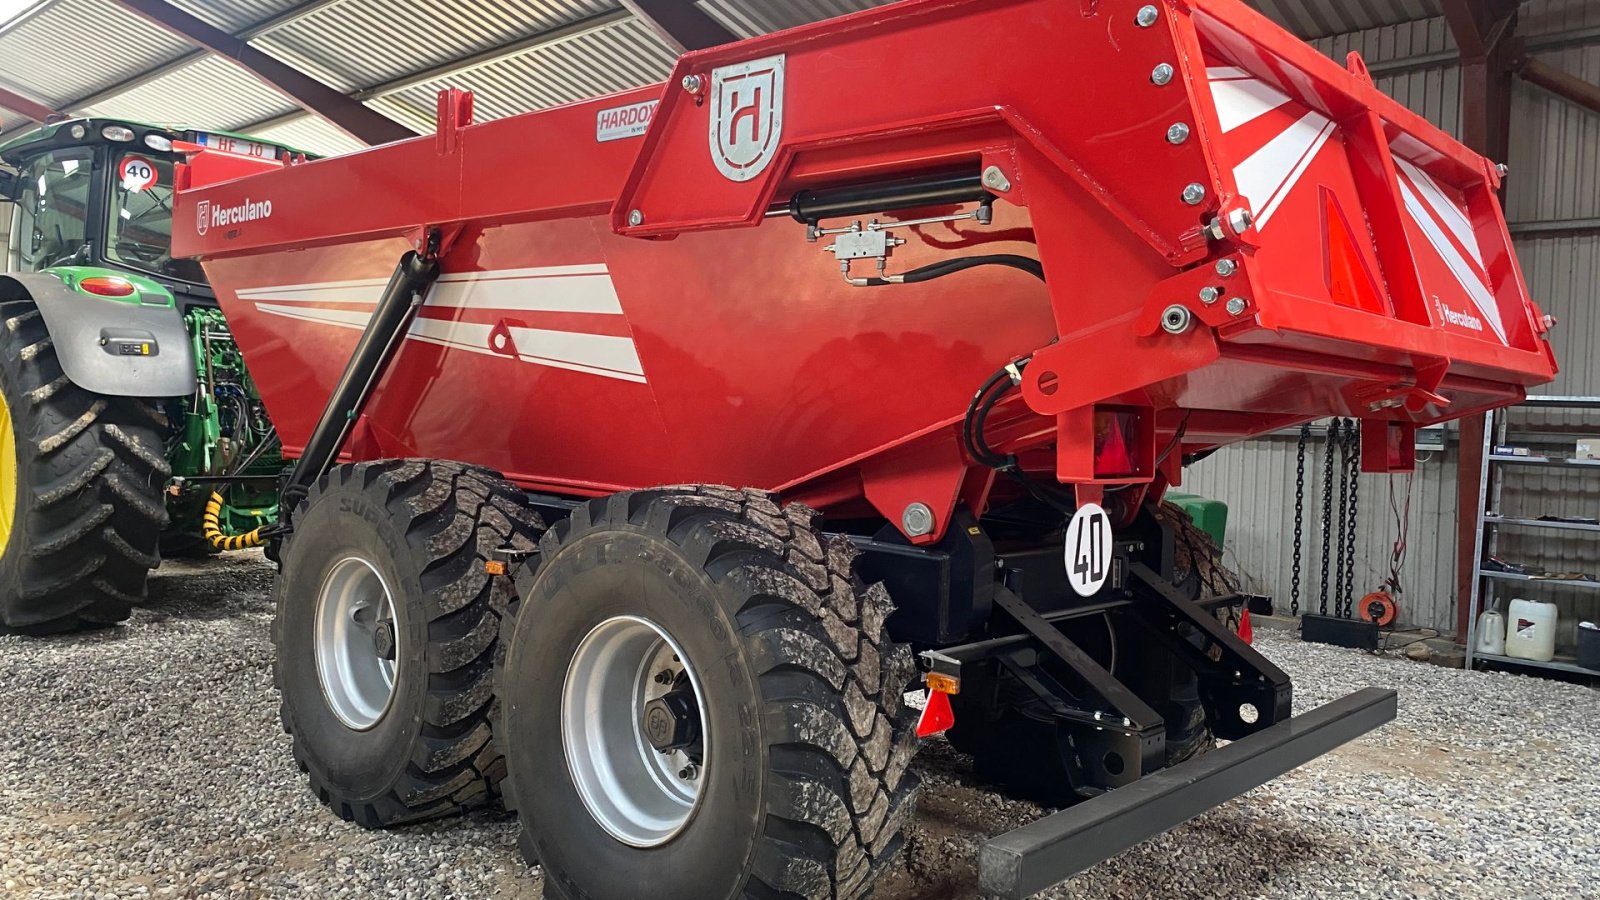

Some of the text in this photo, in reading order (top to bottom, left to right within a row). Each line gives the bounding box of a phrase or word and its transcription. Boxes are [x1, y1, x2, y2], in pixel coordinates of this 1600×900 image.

[218, 137, 263, 157] HF 10
[126, 165, 151, 179] 40
[211, 197, 273, 228] Herculano
[1441, 302, 1483, 332] Herculano
[1073, 512, 1104, 586] 40
